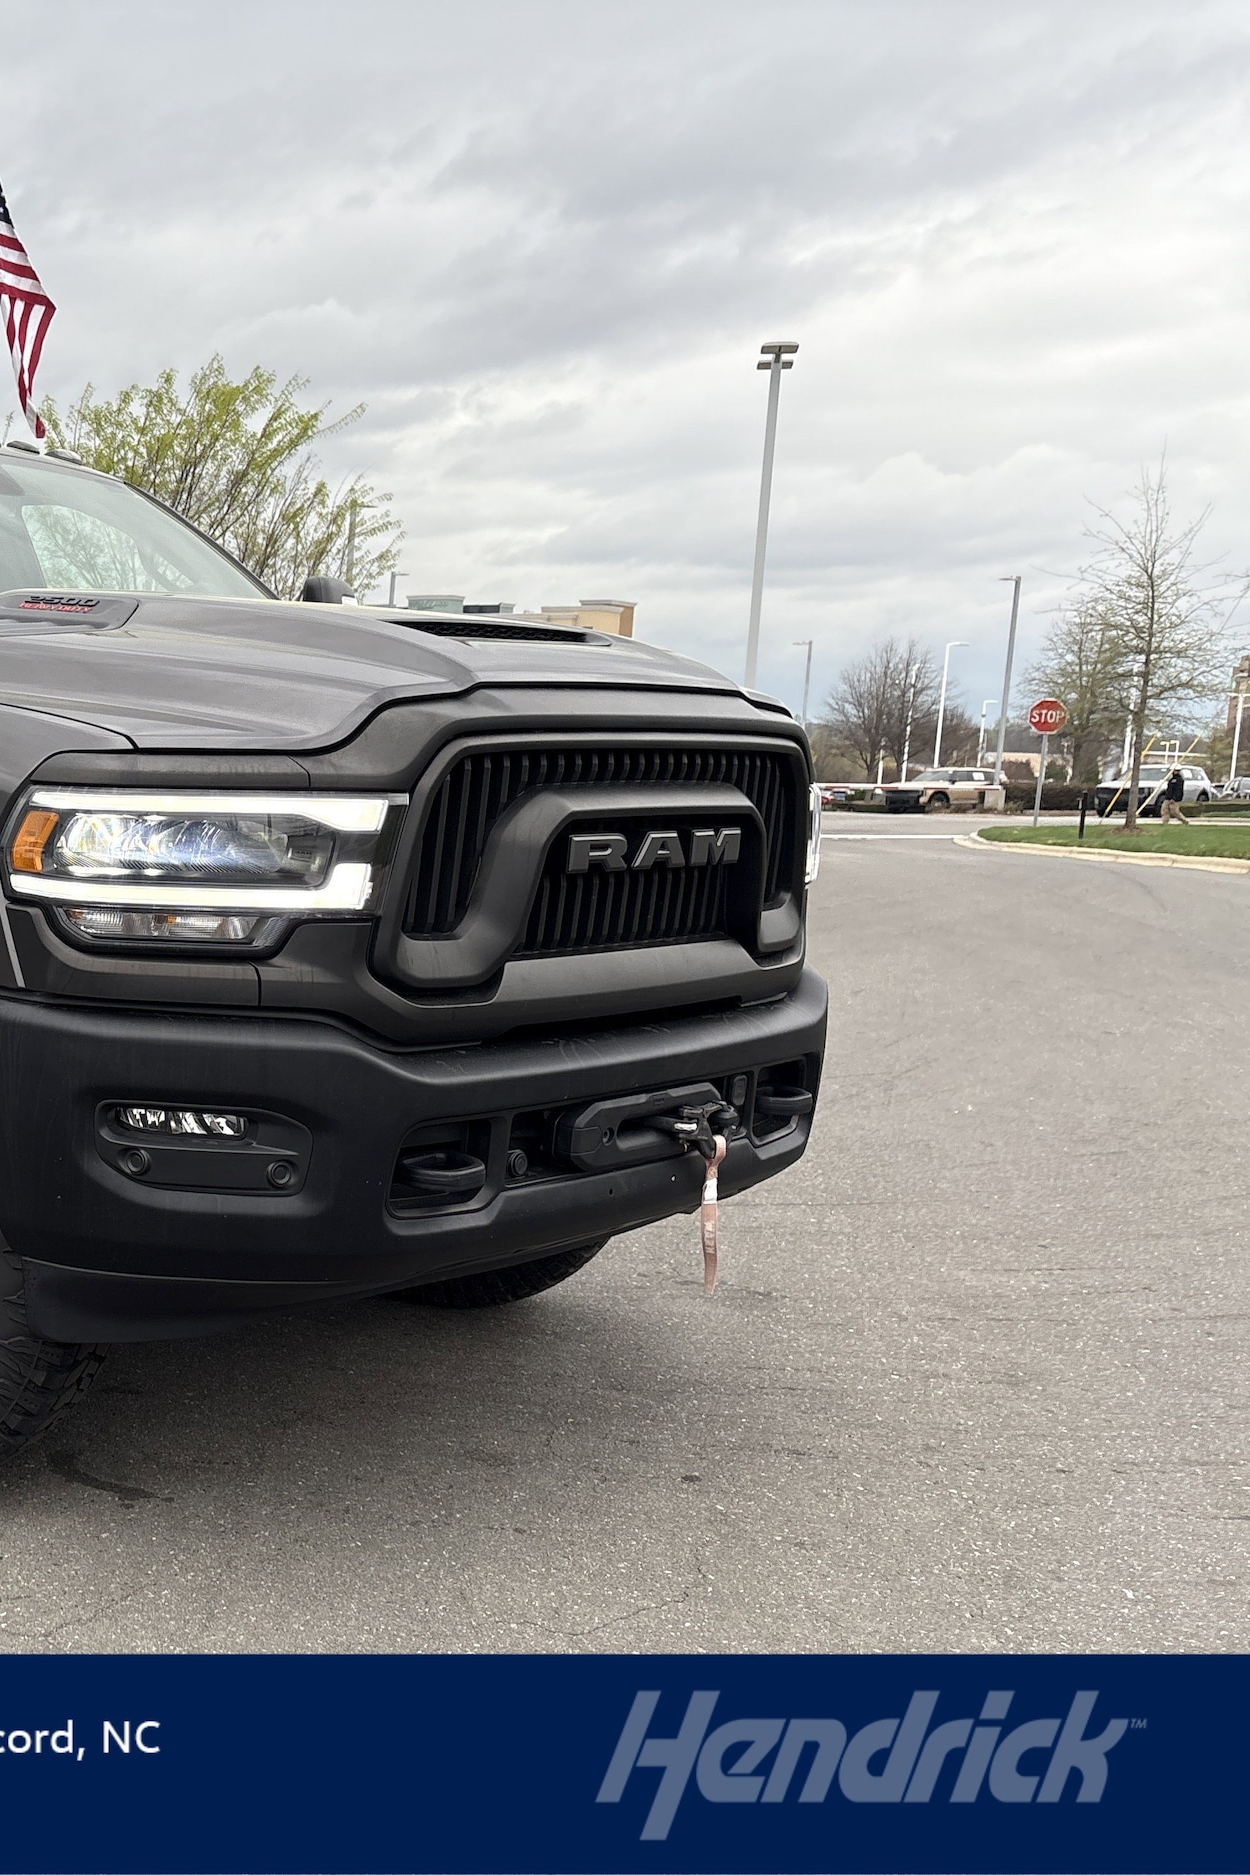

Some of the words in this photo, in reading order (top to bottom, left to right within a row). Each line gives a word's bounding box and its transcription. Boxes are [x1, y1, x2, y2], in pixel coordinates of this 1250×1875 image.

[19, 602, 57, 611] HEAVY
[57, 604, 93, 613] DUTY
[1030, 709, 1065, 723] STOP
[566, 827, 741, 874] RAM
